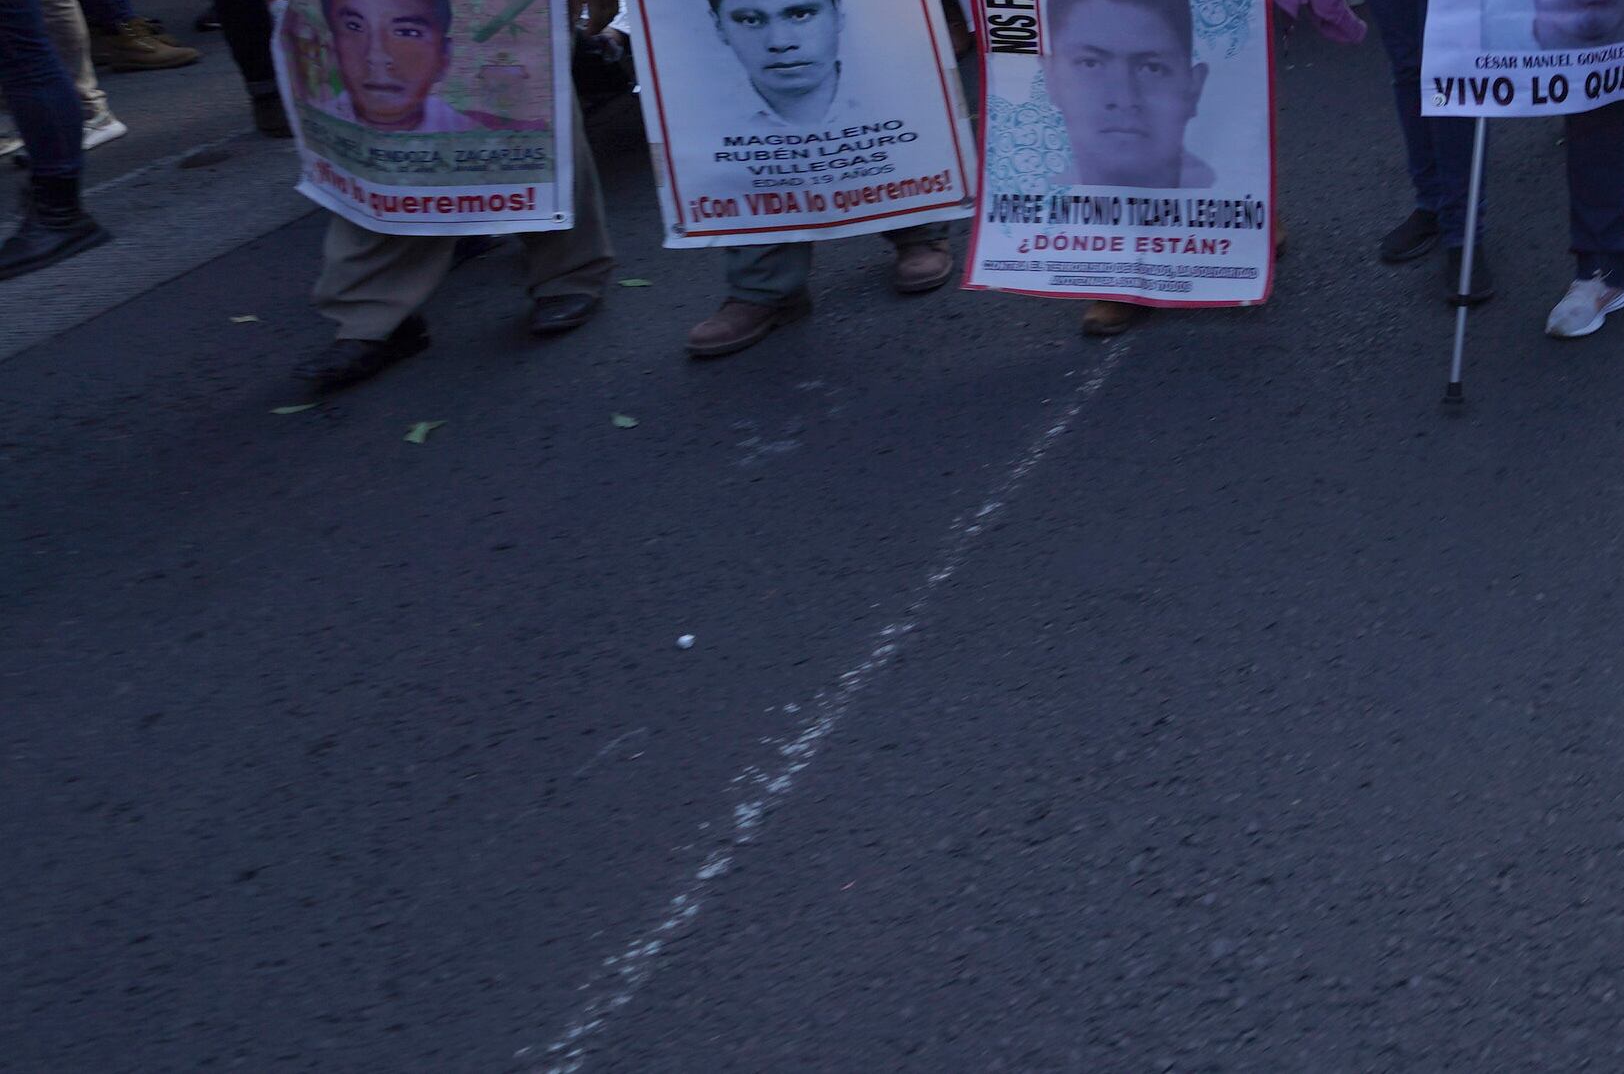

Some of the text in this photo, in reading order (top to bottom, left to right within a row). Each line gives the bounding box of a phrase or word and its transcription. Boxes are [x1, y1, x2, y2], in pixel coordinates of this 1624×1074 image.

[988, 13, 1039, 55] NOS
[1522, 52, 1574, 70] MANUEL
[1531, 72, 1569, 105] LO
[714, 131, 920, 163] RUBÉN LAURO
[723, 119, 905, 148] MAGDALENO
[747, 151, 889, 176] VILLEGAS
[752, 163, 896, 189] EDAD 19 AÑOS
[369, 186, 537, 217] queremos!
[689, 168, 954, 223] ¡Con VIDA lo queremos!
[987, 193, 1266, 230] JORGE ANTONIO TIZAPA LEGIDEÑO
[1018, 232, 1233, 256] ¿DÓNDE ESTÁN?
